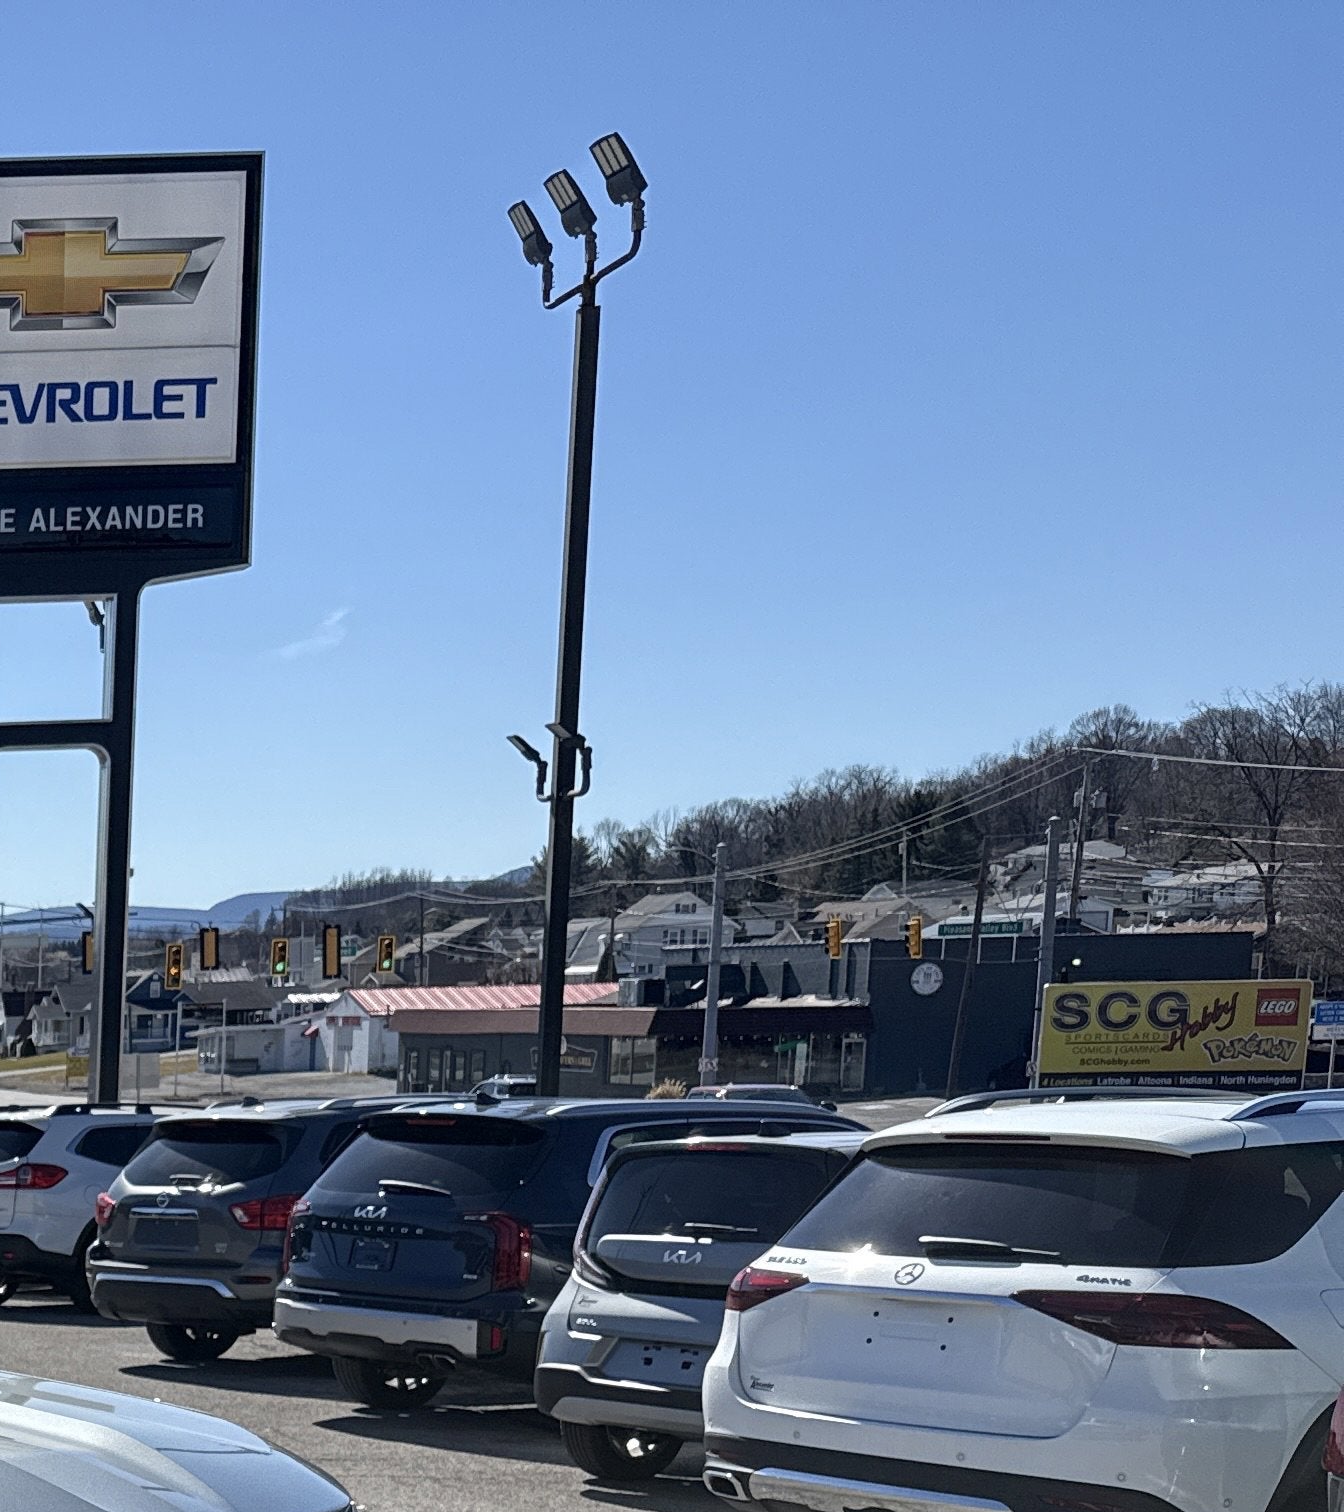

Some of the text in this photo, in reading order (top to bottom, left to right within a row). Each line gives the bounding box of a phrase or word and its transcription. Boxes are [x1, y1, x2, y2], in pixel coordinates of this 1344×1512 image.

[28, 503, 205, 534] ALEXANDER
[943, 924, 972, 934] Pleasan
[1050, 989, 1190, 1033] SCG
[1258, 999, 1297, 1015] LEGO
[1160, 991, 1240, 1051] Hobby
[1065, 1032, 1170, 1042] SPORTSCARDS
[1072, 1044, 1161, 1055] COMICS GAMING
[1079, 1058, 1151, 1067] SCGhobby.com
[1050, 1077, 1093, 1087] Locations
[1097, 1076, 1132, 1086] Latrobe
[1137, 1075, 1173, 1086] Altoona
[1179, 1075, 1214, 1085] Indiana
[1220, 1074, 1246, 1085] North
[1075, 1274, 1133, 1287] 4MATIC
